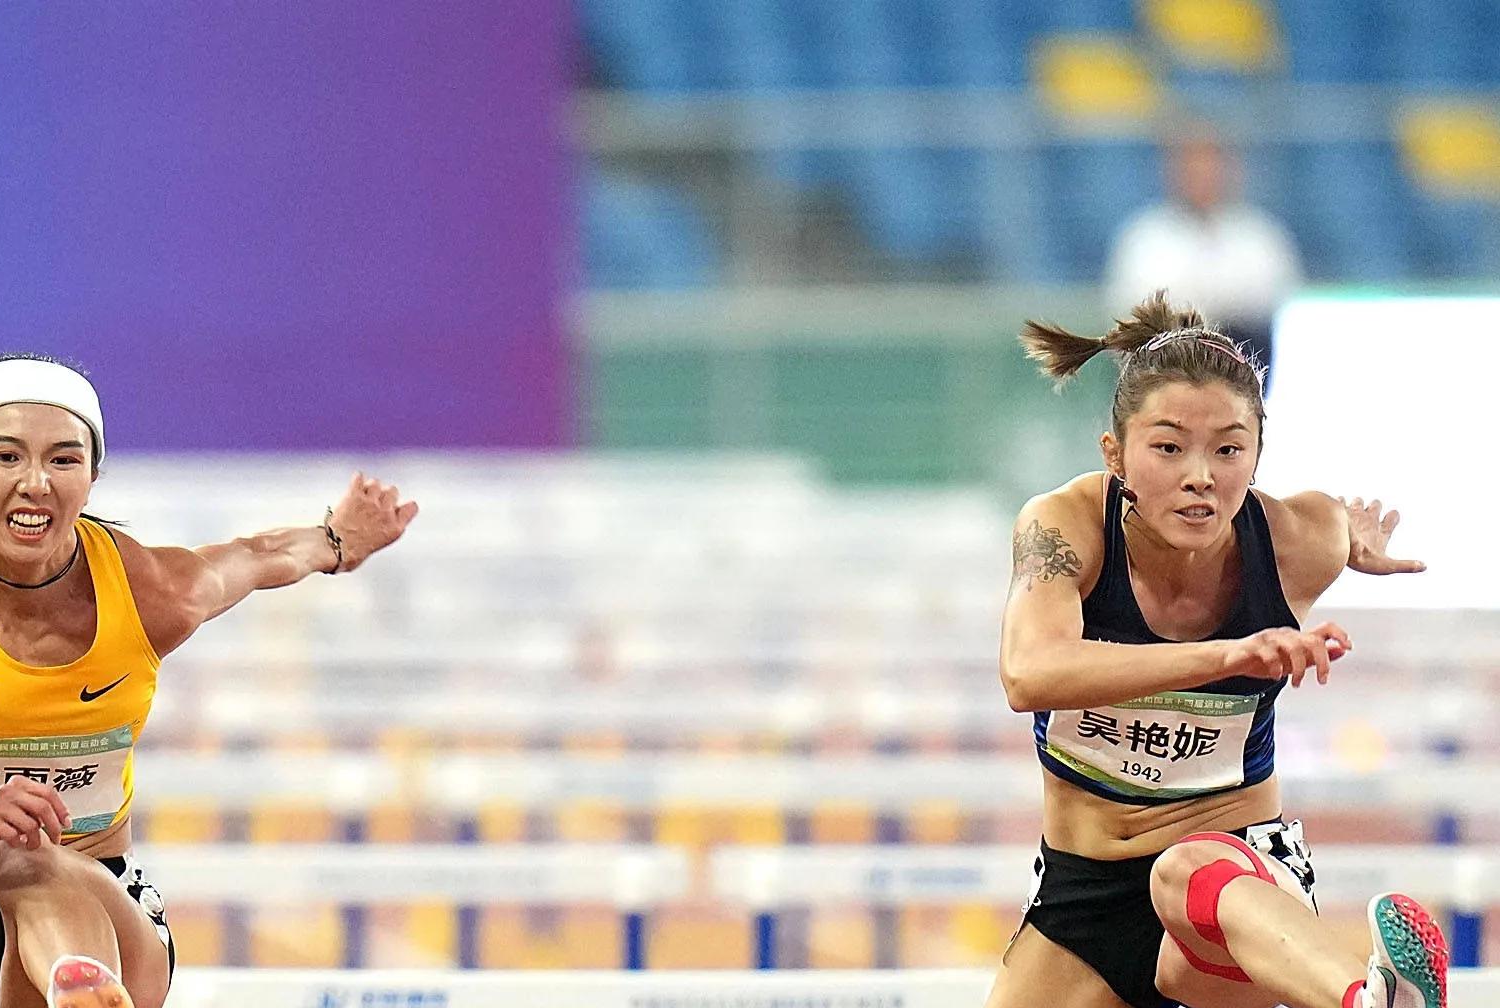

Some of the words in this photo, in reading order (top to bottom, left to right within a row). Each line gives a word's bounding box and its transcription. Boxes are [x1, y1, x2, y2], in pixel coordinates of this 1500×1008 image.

[1077, 709, 1221, 763] 吴艳妮
[1119, 760, 1162, 783] 1942
